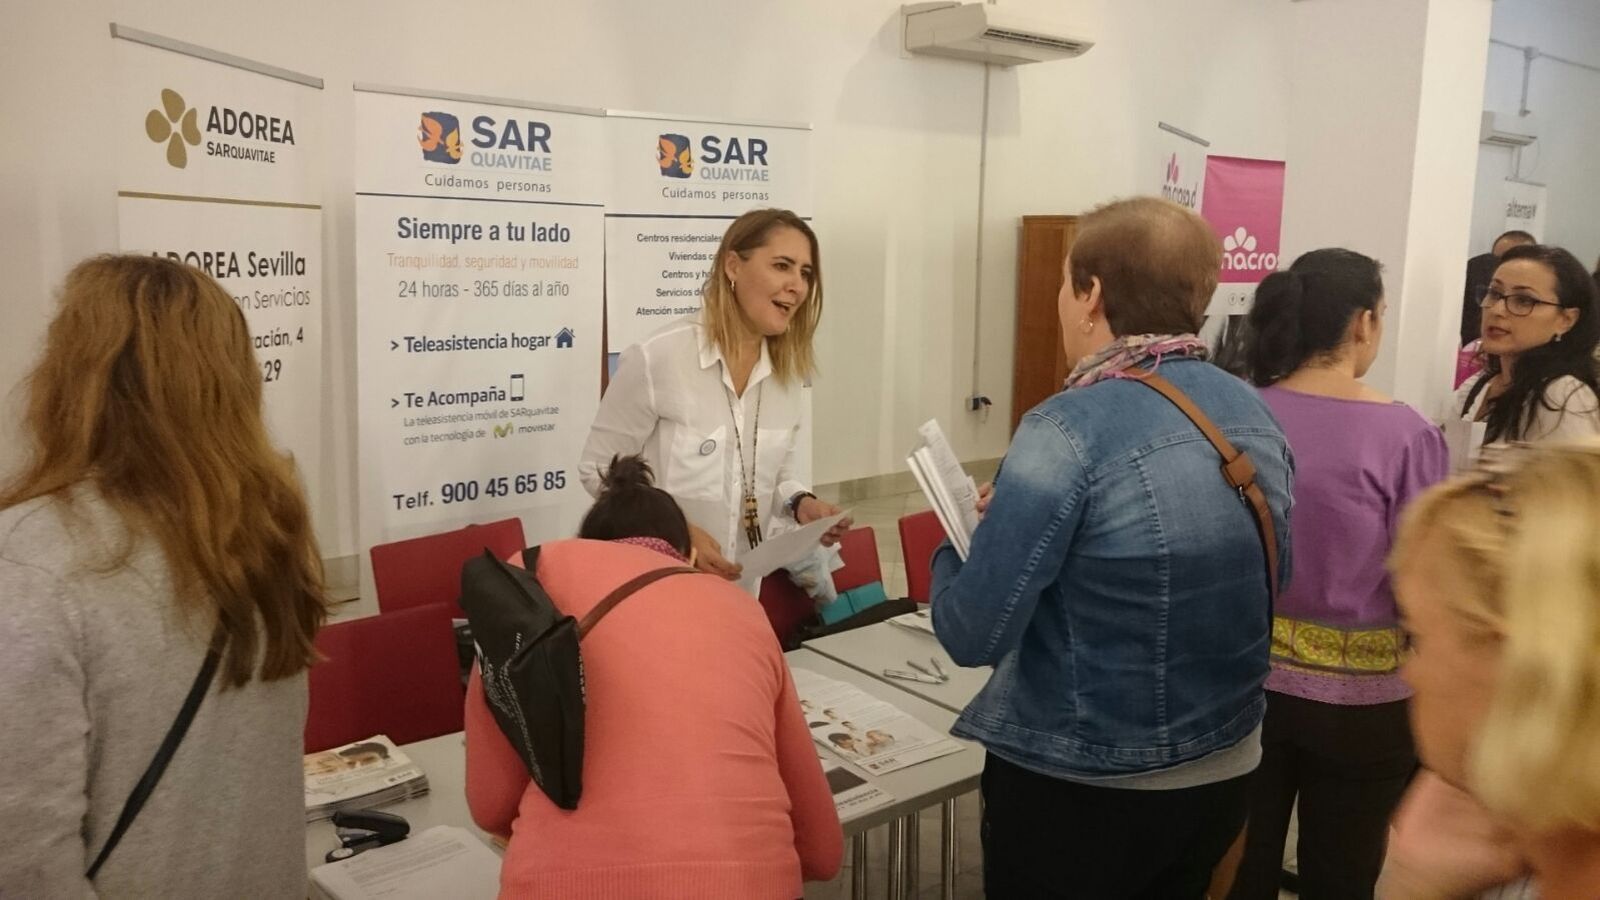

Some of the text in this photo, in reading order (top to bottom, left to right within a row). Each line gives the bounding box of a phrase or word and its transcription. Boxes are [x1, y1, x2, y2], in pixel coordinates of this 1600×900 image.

[206, 105, 295, 146] ADOREA
[470, 115, 552, 153] SAR
[206, 141, 276, 163] SARQUAVITAE
[700, 135, 768, 166] SAR
[470, 152, 552, 171] QUAVITAE
[424, 173, 552, 193] Cuidamos personas
[700, 167, 769, 182] QUAVITAE
[661, 187, 769, 202] Cuidamos personas
[397, 217, 571, 244] Siempre a tu lado
[637, 233, 669, 243] Centros
[152, 250, 306, 279] OREA Sevilla
[465, 254, 517, 271] seguridad
[520, 256, 527, 271] y
[529, 254, 579, 269] movilidad
[669, 251, 707, 261] Viviendas
[662, 270, 694, 279] Centros
[695, 271, 700, 280] y
[254, 286, 311, 310] Servicios
[398, 280, 417, 298] 24
[422, 281, 459, 298] horas
[474, 280, 499, 297] 365
[503, 280, 529, 297] días
[532, 281, 543, 297] al
[546, 281, 570, 297] año
[656, 288, 693, 297] Servicios
[636, 307, 672, 316] Atención
[296, 326, 304, 343] 4
[403, 332, 552, 353] Teleasistencia hogar
[264, 358, 282, 383] 29
[403, 385, 506, 408] Te Acompaña
[403, 405, 560, 427] La teleasistencia móvil de SARquavitae
[404, 422, 556, 446] con la tecnología de movistar
[392, 470, 566, 510] Telf. 900 45 65 85
